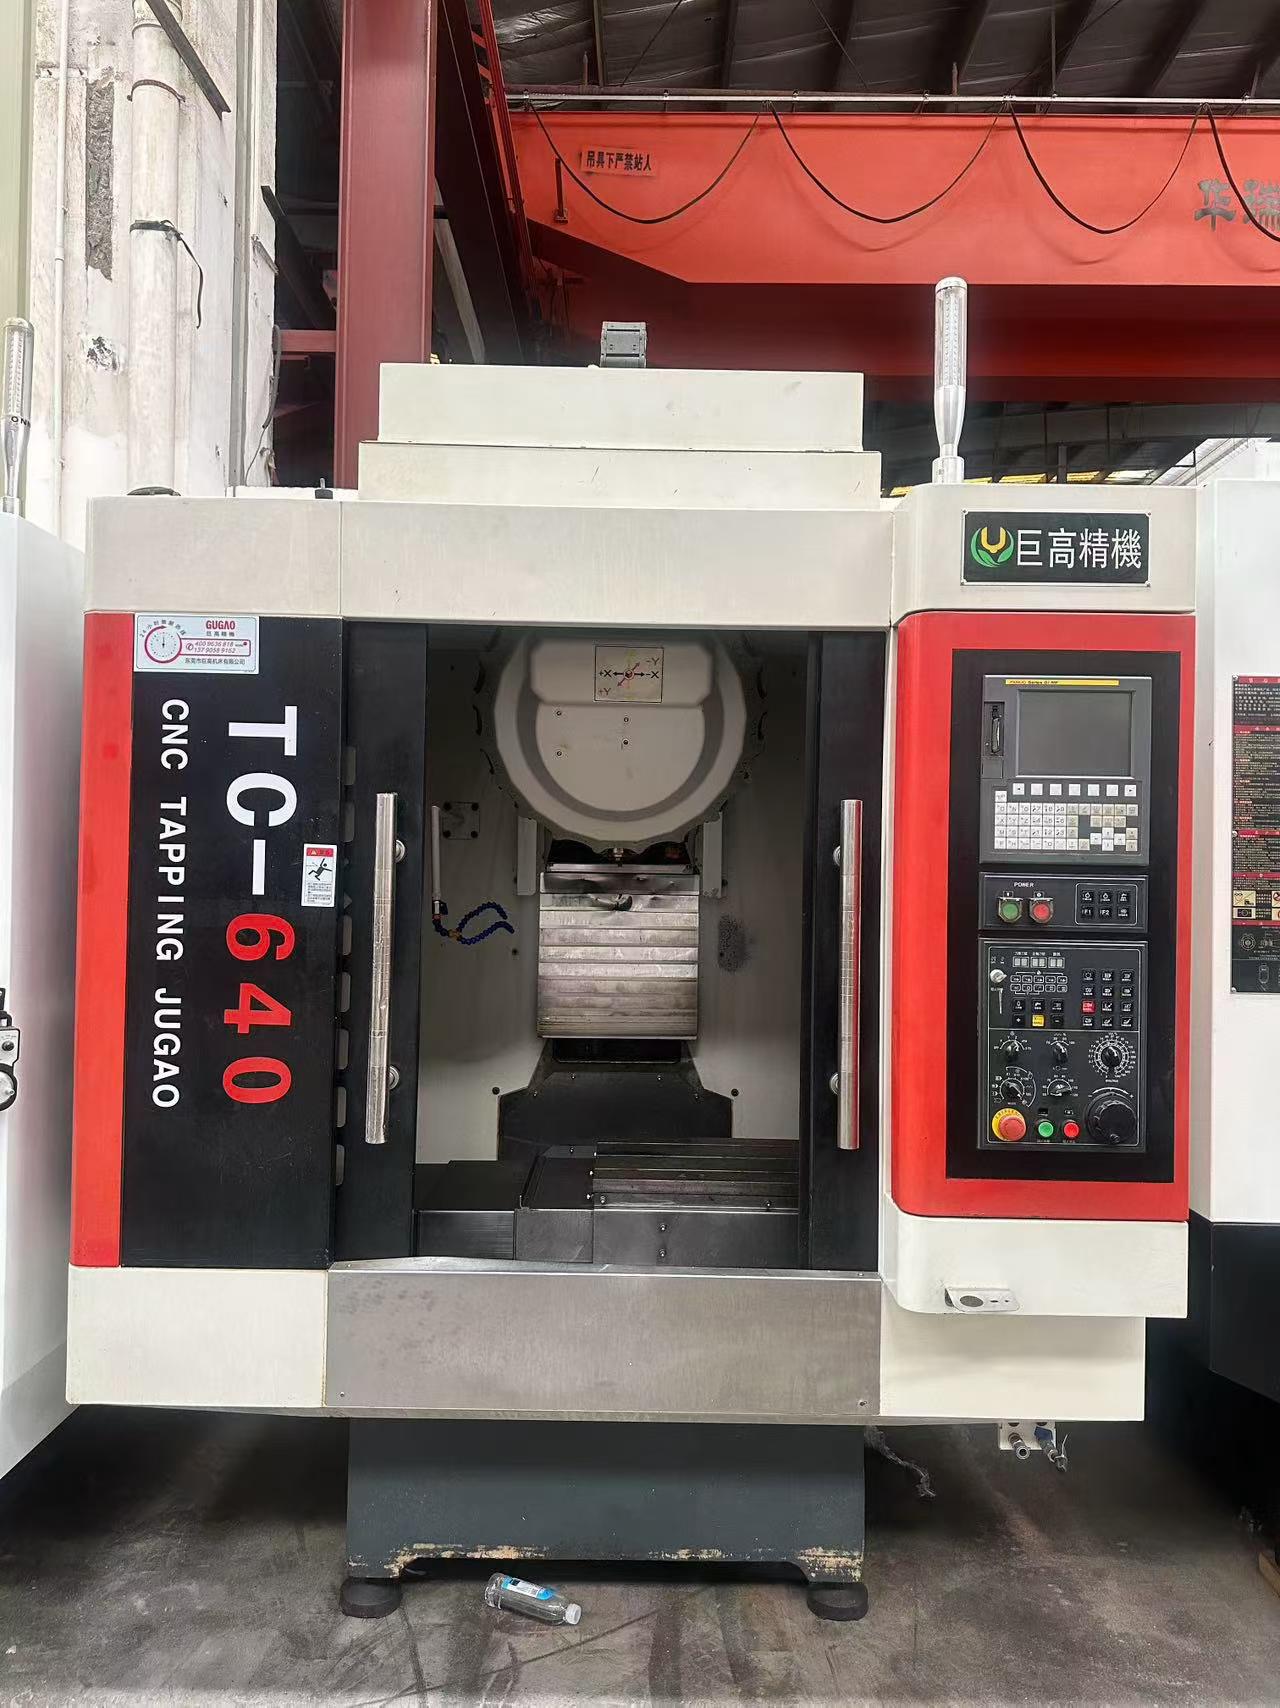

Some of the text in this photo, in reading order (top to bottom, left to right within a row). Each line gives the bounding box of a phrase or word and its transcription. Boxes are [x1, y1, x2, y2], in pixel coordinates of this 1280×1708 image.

[586, 150, 652, 171] 吊具下严禁站人
[1016, 528, 1142, 569] 巨高精機
[206, 620, 236, 630] GUGAO
[151, 697, 190, 1109] CNC TAPPING JUGAO
